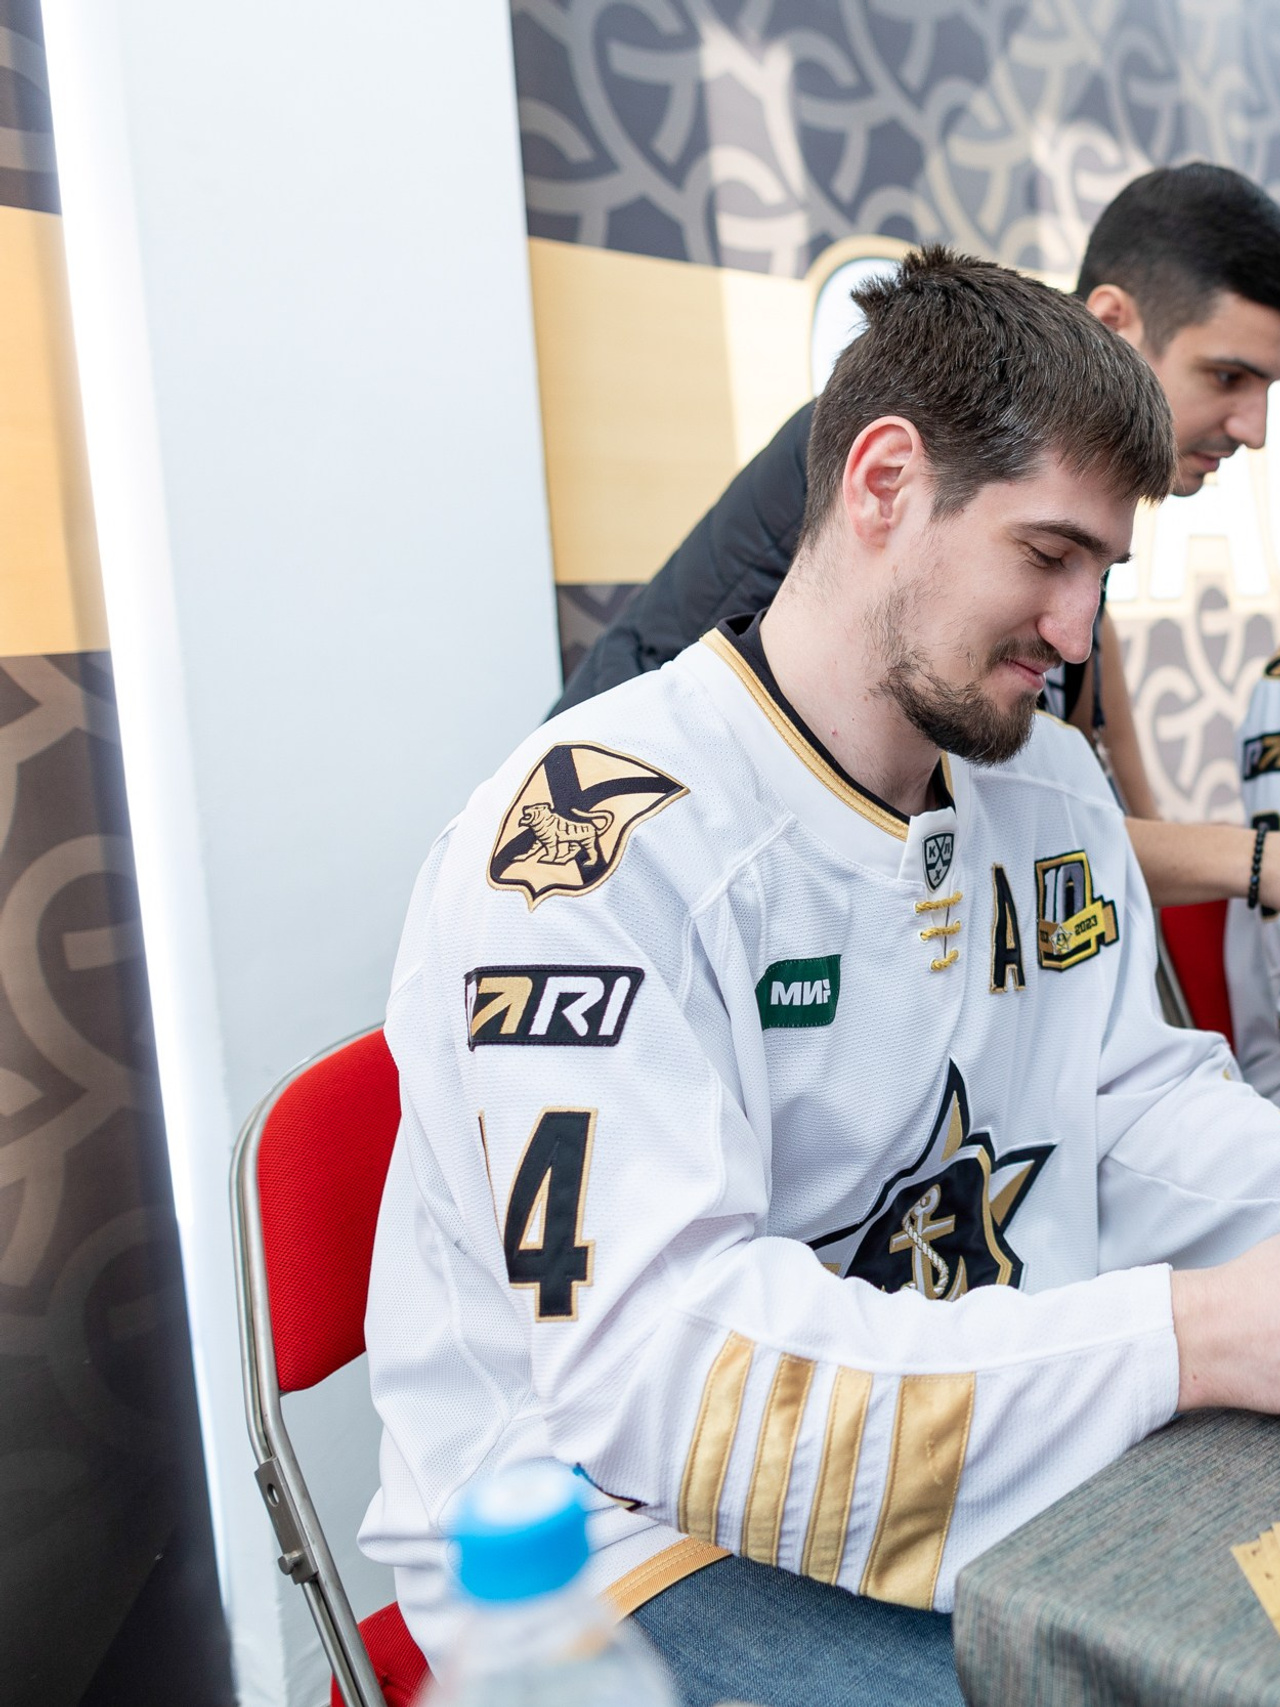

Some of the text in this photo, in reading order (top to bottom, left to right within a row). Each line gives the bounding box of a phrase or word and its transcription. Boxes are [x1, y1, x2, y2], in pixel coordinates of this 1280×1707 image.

[990, 862, 1026, 994] A
[1074, 913, 1099, 936] 2023
[467, 975, 632, 1041] ARI
[478, 1106, 599, 1323] 4
